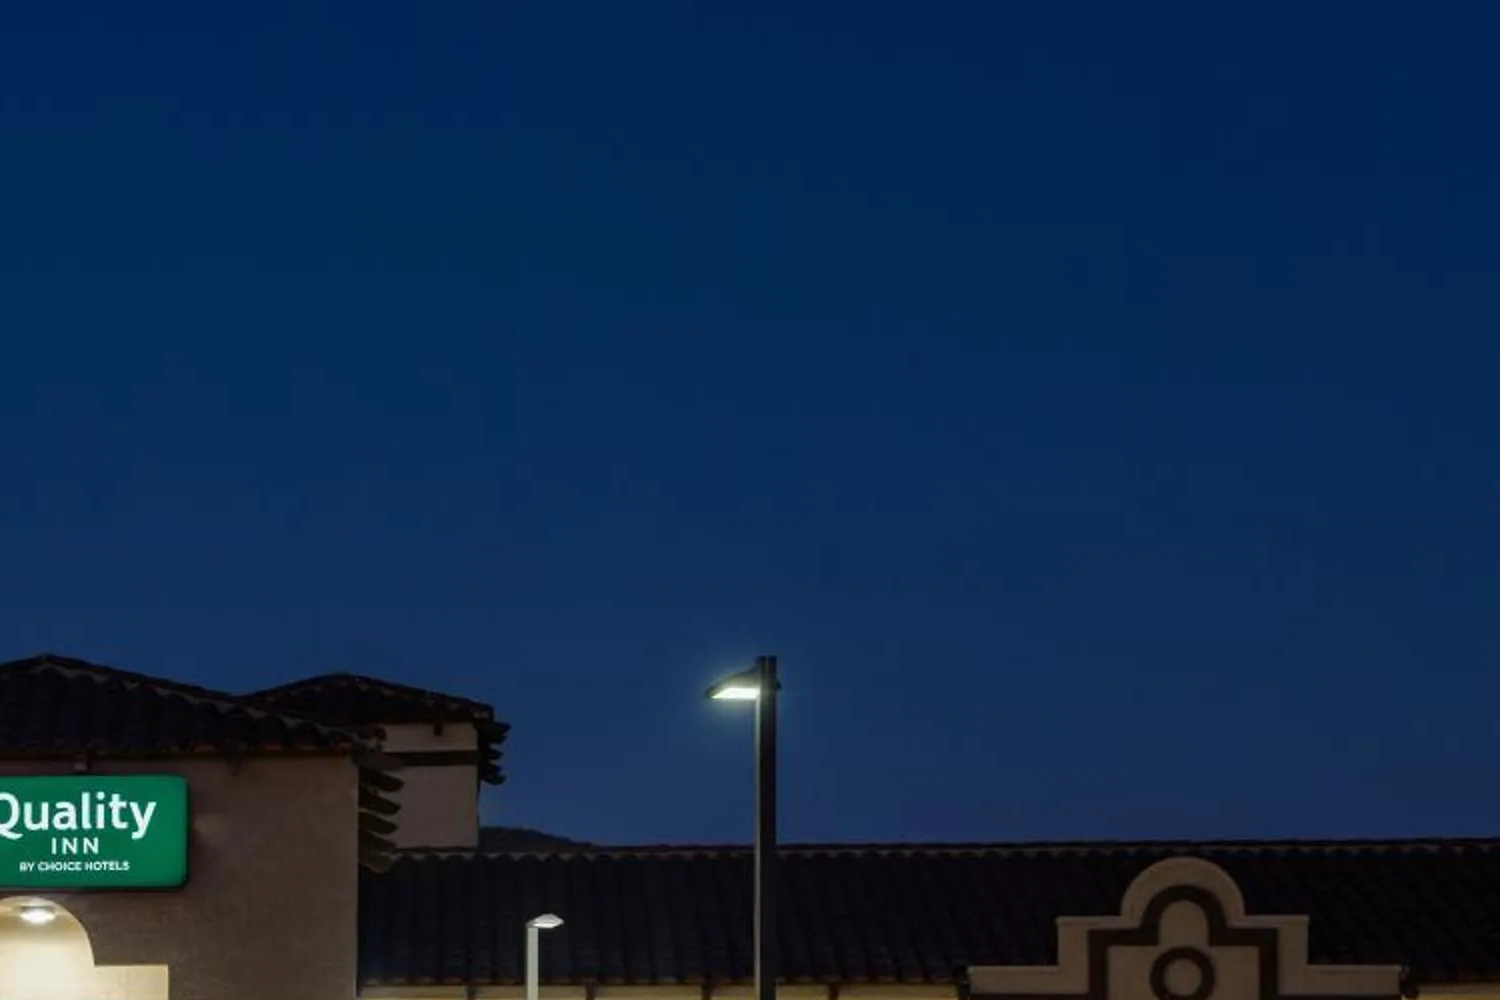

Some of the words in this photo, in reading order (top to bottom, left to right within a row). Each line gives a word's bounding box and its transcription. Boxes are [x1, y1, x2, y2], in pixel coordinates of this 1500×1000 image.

[51, 837, 100, 854] INN
[19, 861, 35, 872] BY
[37, 861, 82, 872] CHOICE
[84, 861, 131, 872] HOTELS
